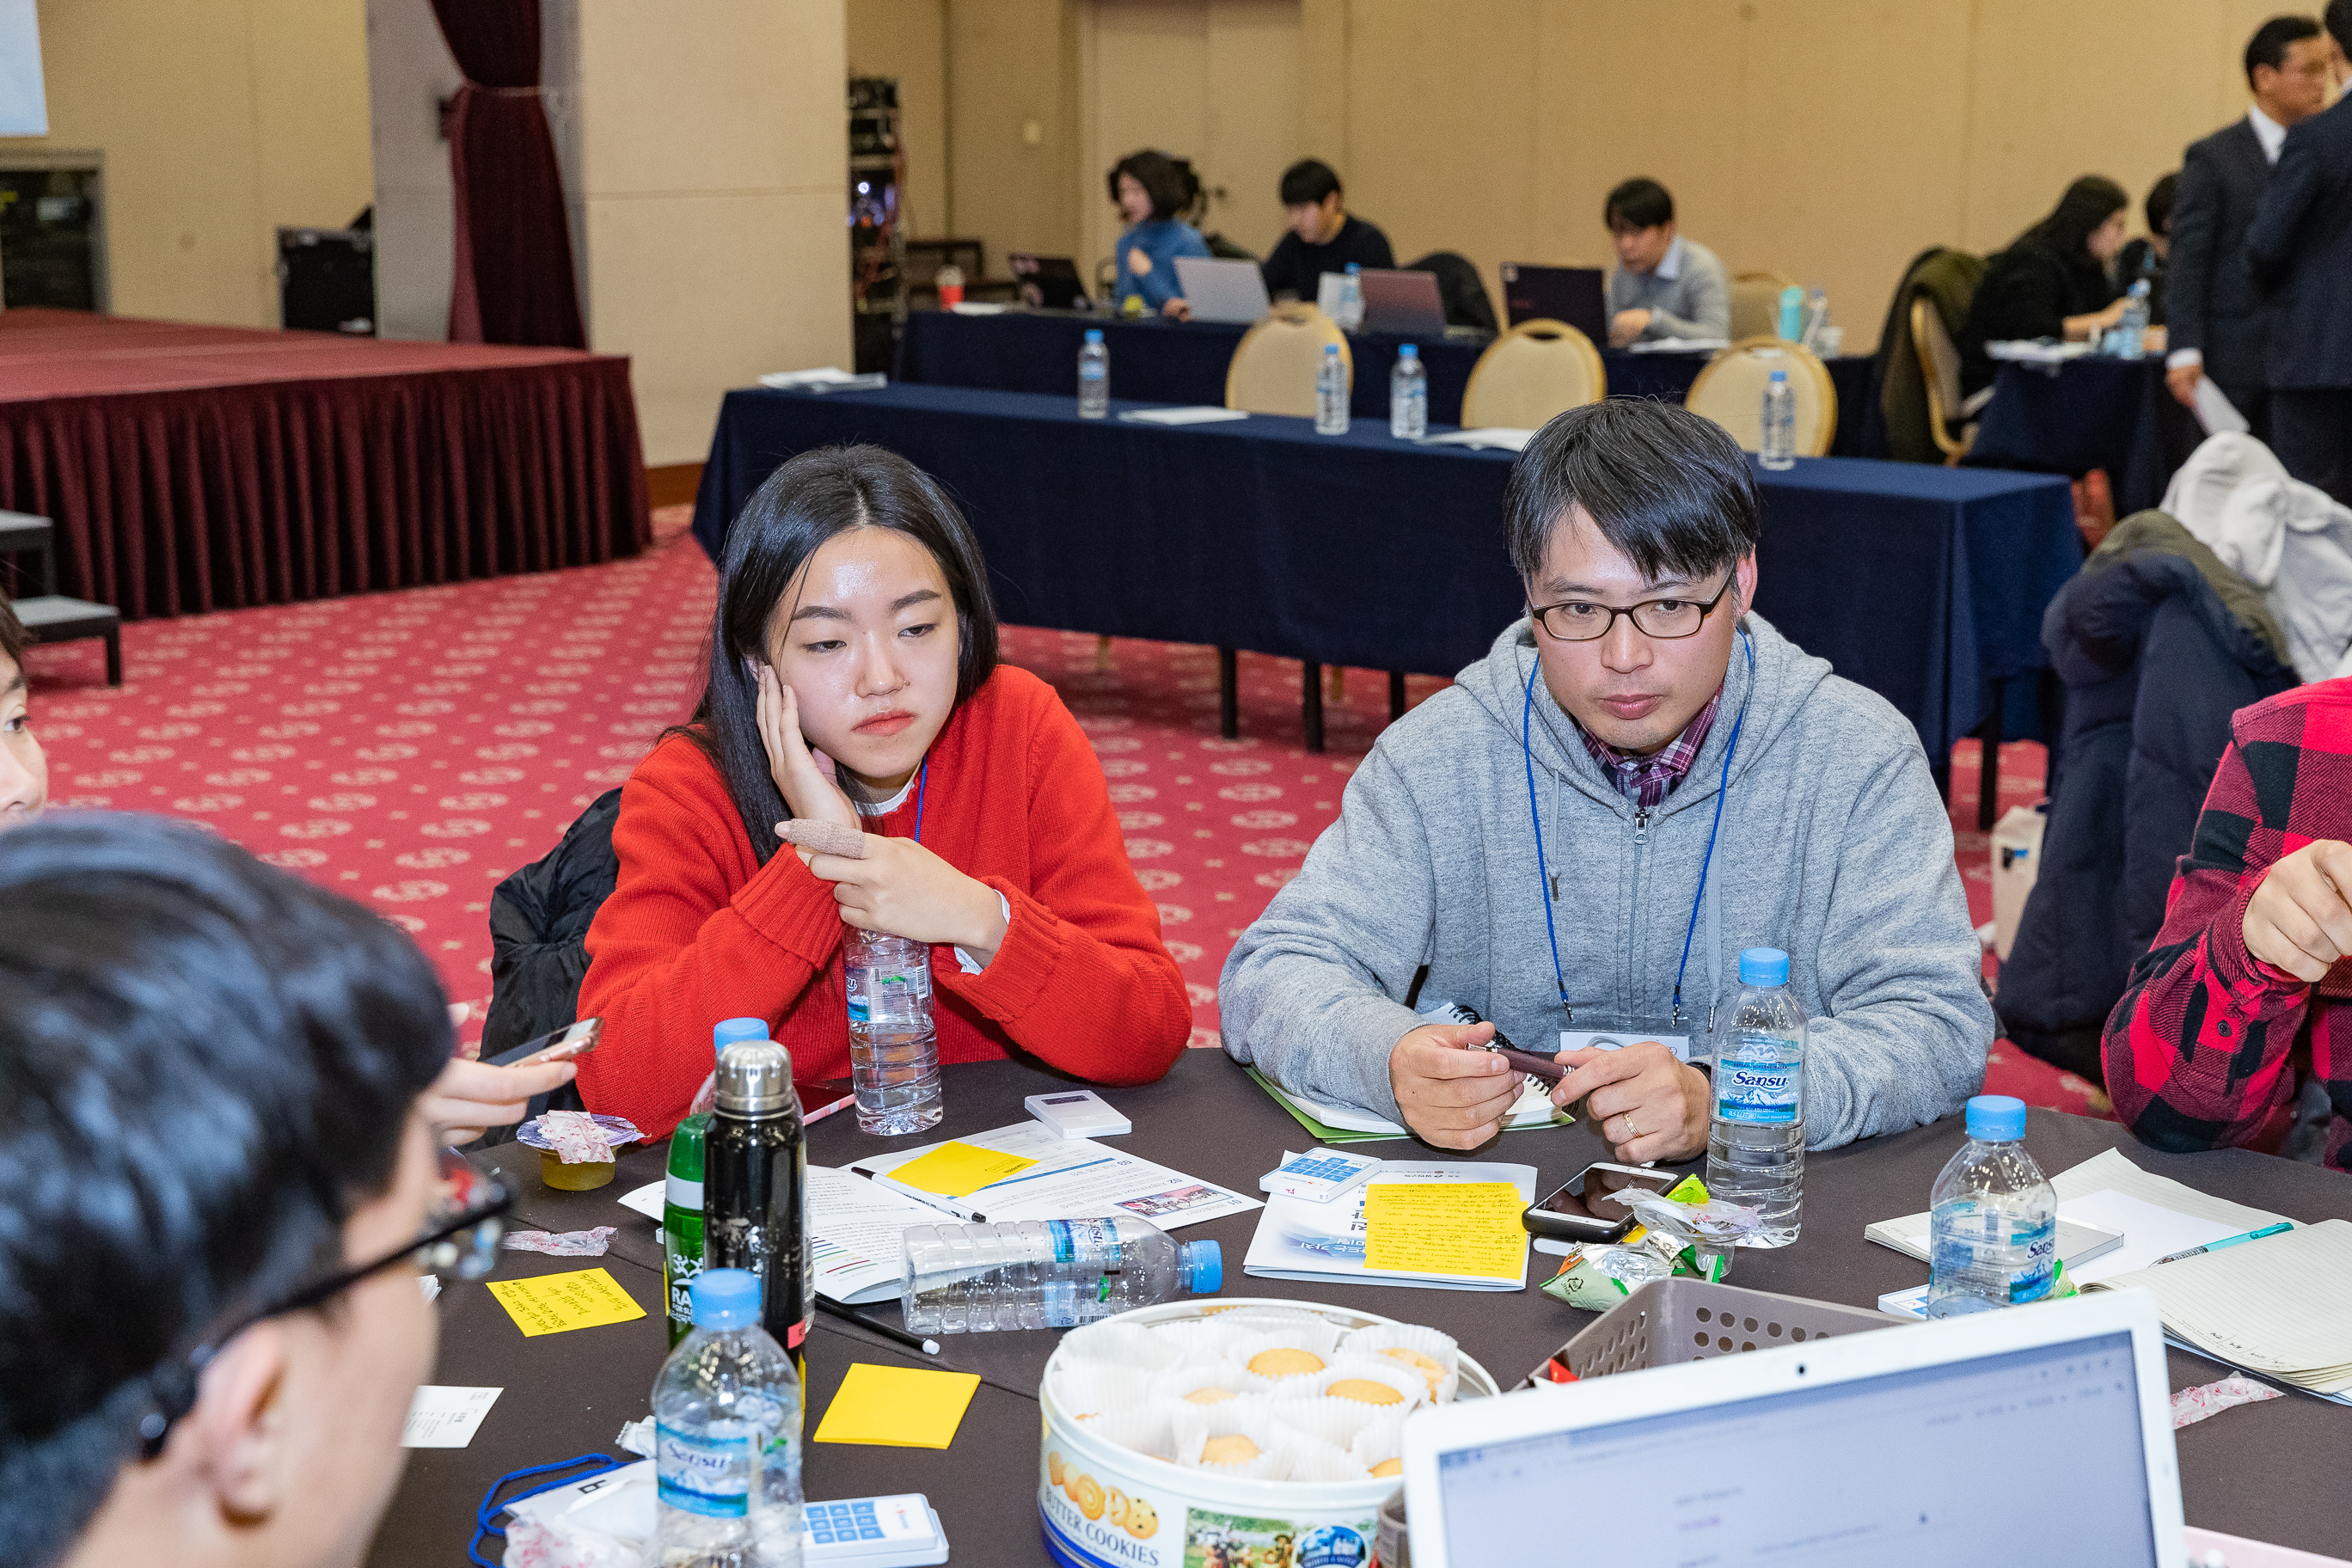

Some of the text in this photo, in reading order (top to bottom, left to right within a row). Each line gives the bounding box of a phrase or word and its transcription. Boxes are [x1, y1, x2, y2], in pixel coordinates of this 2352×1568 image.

[1733, 1071, 1789, 1089] Sansu
[1300, 1241, 1330, 1251] 가치
[672, 1302, 683, 1313] FOR
[1044, 1484, 1082, 1532] BUTTER
[1085, 1522, 1160, 1566] COOKIES
